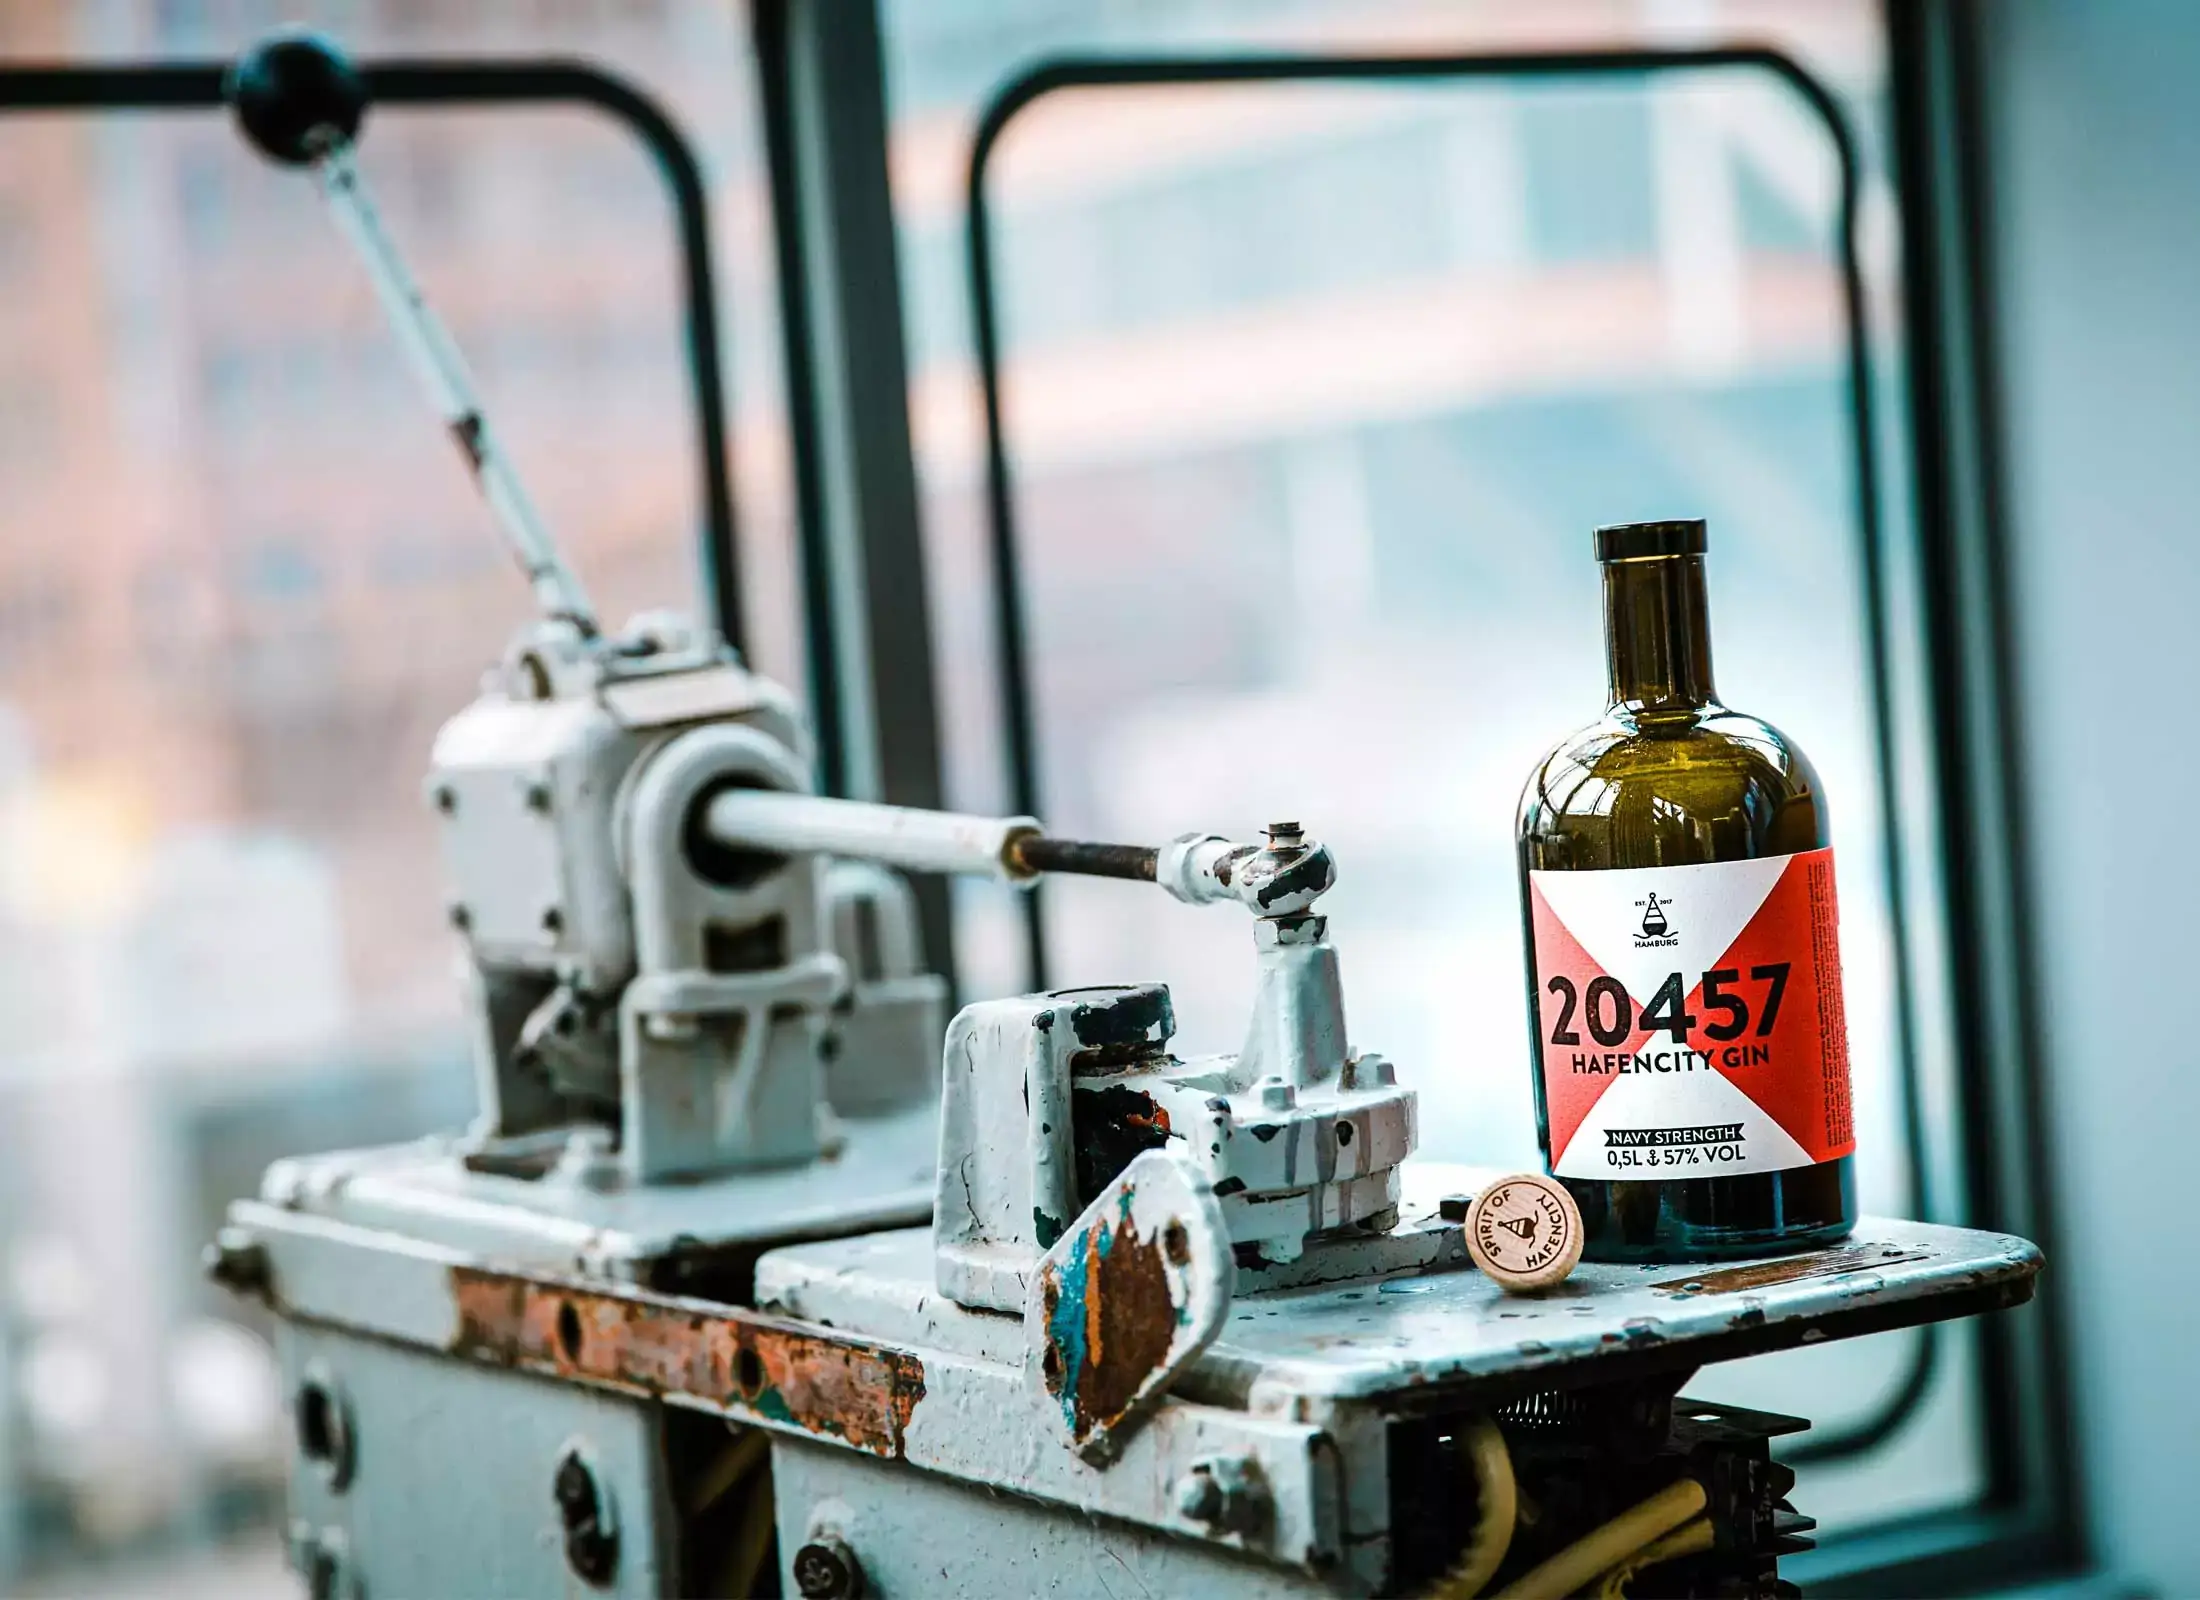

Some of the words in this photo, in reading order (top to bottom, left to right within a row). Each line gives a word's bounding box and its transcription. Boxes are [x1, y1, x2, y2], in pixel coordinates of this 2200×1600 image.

[1634, 939, 1678, 948] HAMBURG
[1548, 962, 1791, 1047] 20457
[1572, 1048, 1716, 1074] HAFENCITY
[1722, 1044, 1770, 1068] GIN
[1612, 1131, 1651, 1144] NAVY
[1655, 1127, 1736, 1144] STRENGTH
[1607, 1150, 1643, 1170] 0,5L
[1664, 1148, 1699, 1165] 57%
[1703, 1144, 1746, 1162] VOL
[1480, 1209, 1502, 1258] SPIRIT
[1491, 1189, 1511, 1207] OF
[1525, 1194, 1562, 1268] HAFENCITY
